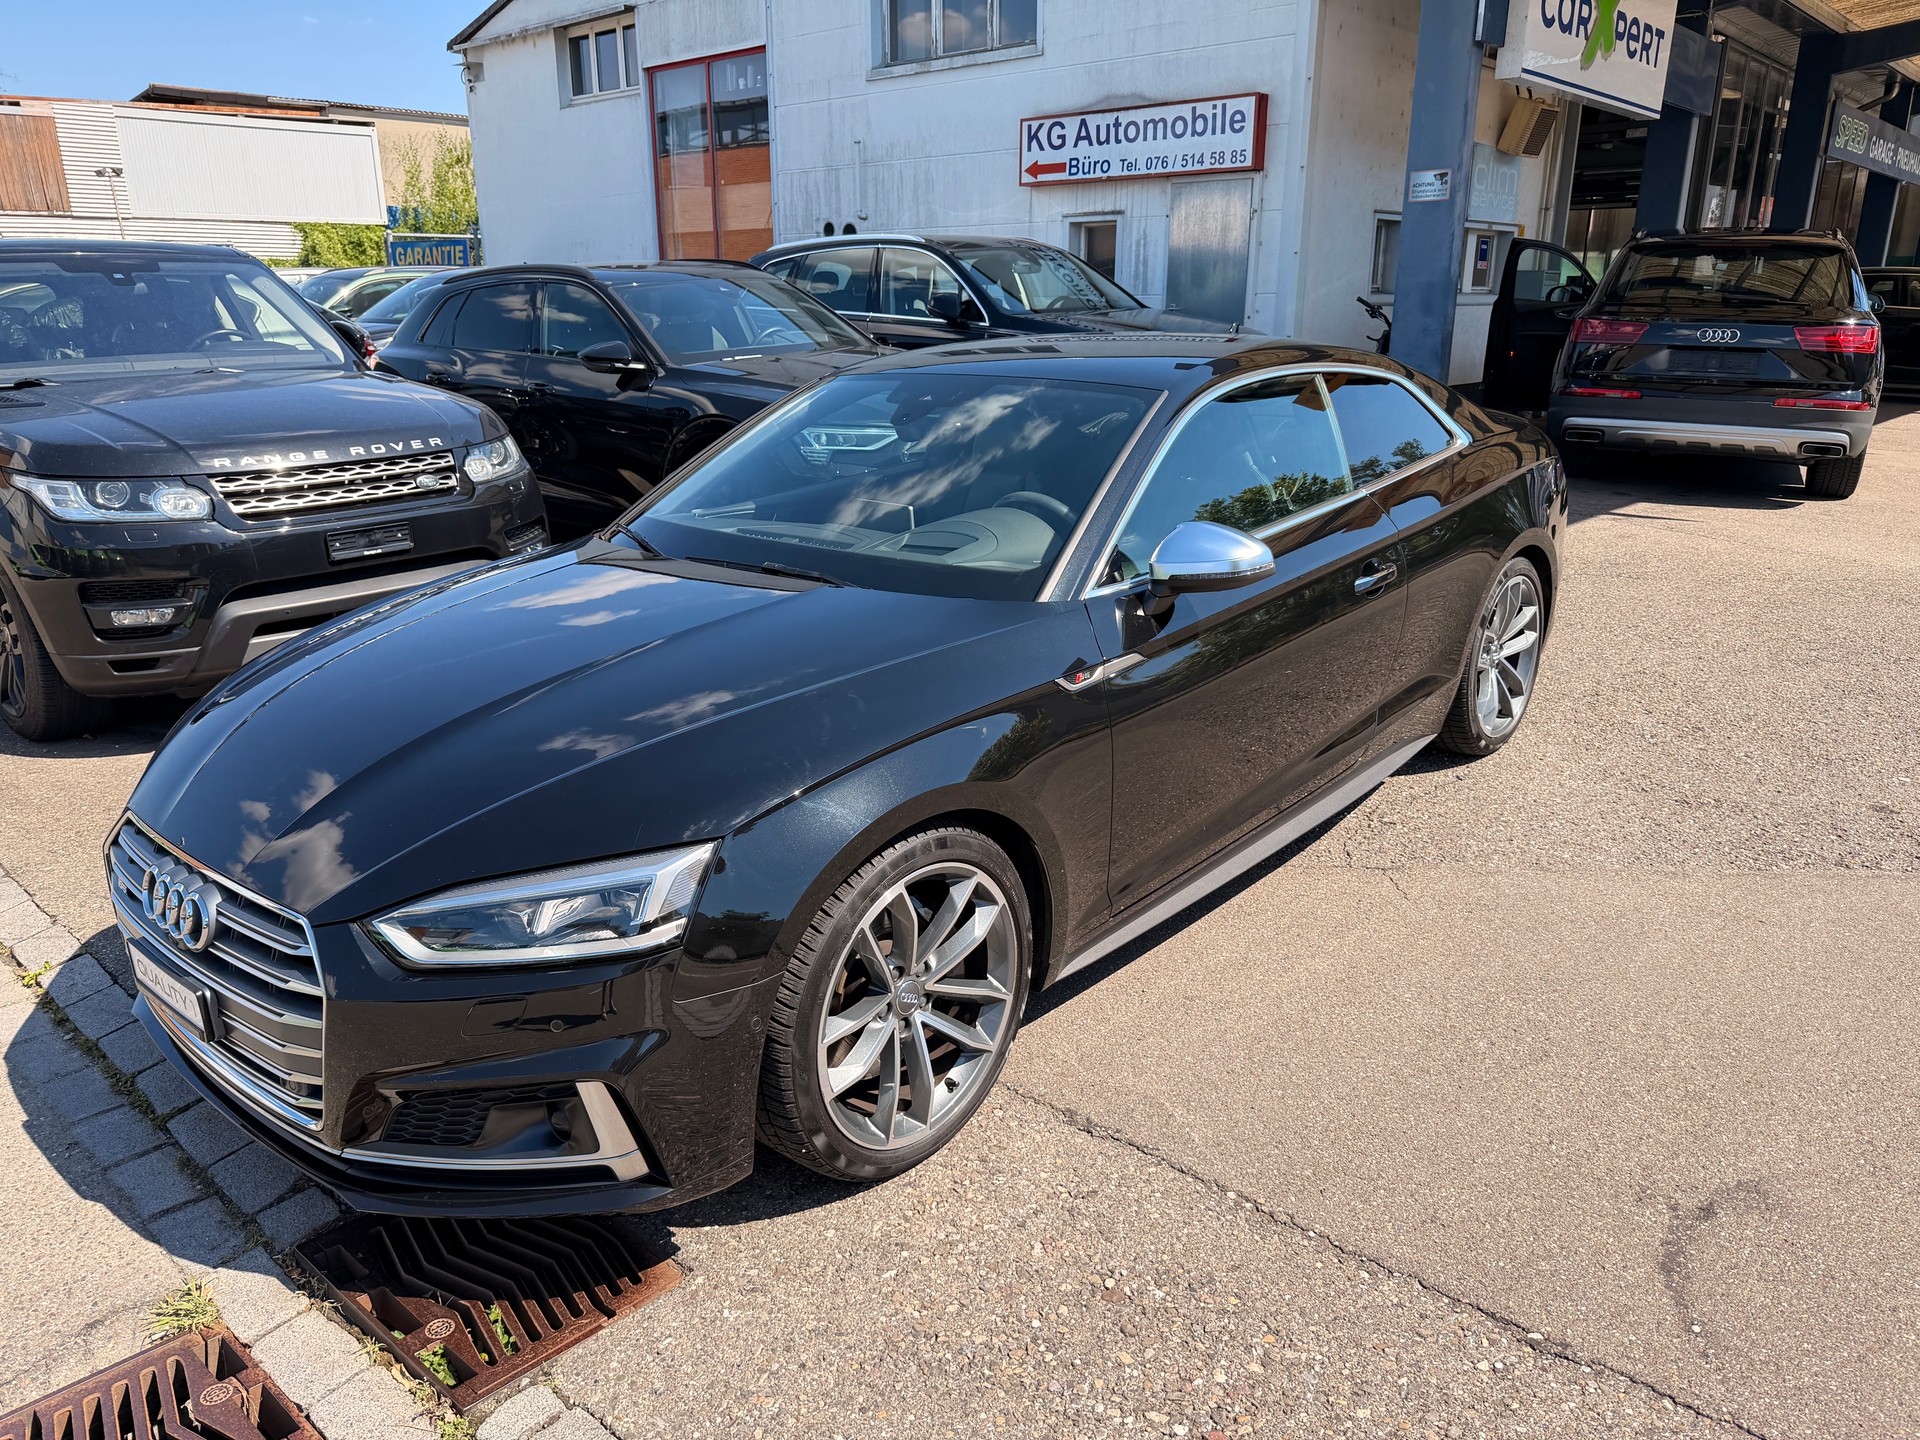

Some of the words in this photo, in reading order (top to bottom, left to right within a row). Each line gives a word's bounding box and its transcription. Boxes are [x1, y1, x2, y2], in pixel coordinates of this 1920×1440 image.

[1026, 121, 1067, 153] KG
[1073, 103, 1246, 148] Automobile
[1835, 114, 1870, 155] SPEED
[1067, 155, 1111, 177] Büro
[1119, 157, 1141, 173] Tel.
[1145, 155, 1169, 171] 076
[1180, 152, 1205, 168] 514
[1209, 150, 1225, 166] 58
[1230, 148, 1247, 164] 85
[1869, 135, 1895, 164] GARAGE
[1474, 156, 1518, 194] clim
[1472, 190, 1515, 211] service
[395, 245, 464, 265] GARANTIE
[213, 449, 329, 468] RANGE
[349, 437, 443, 456] ROVER
